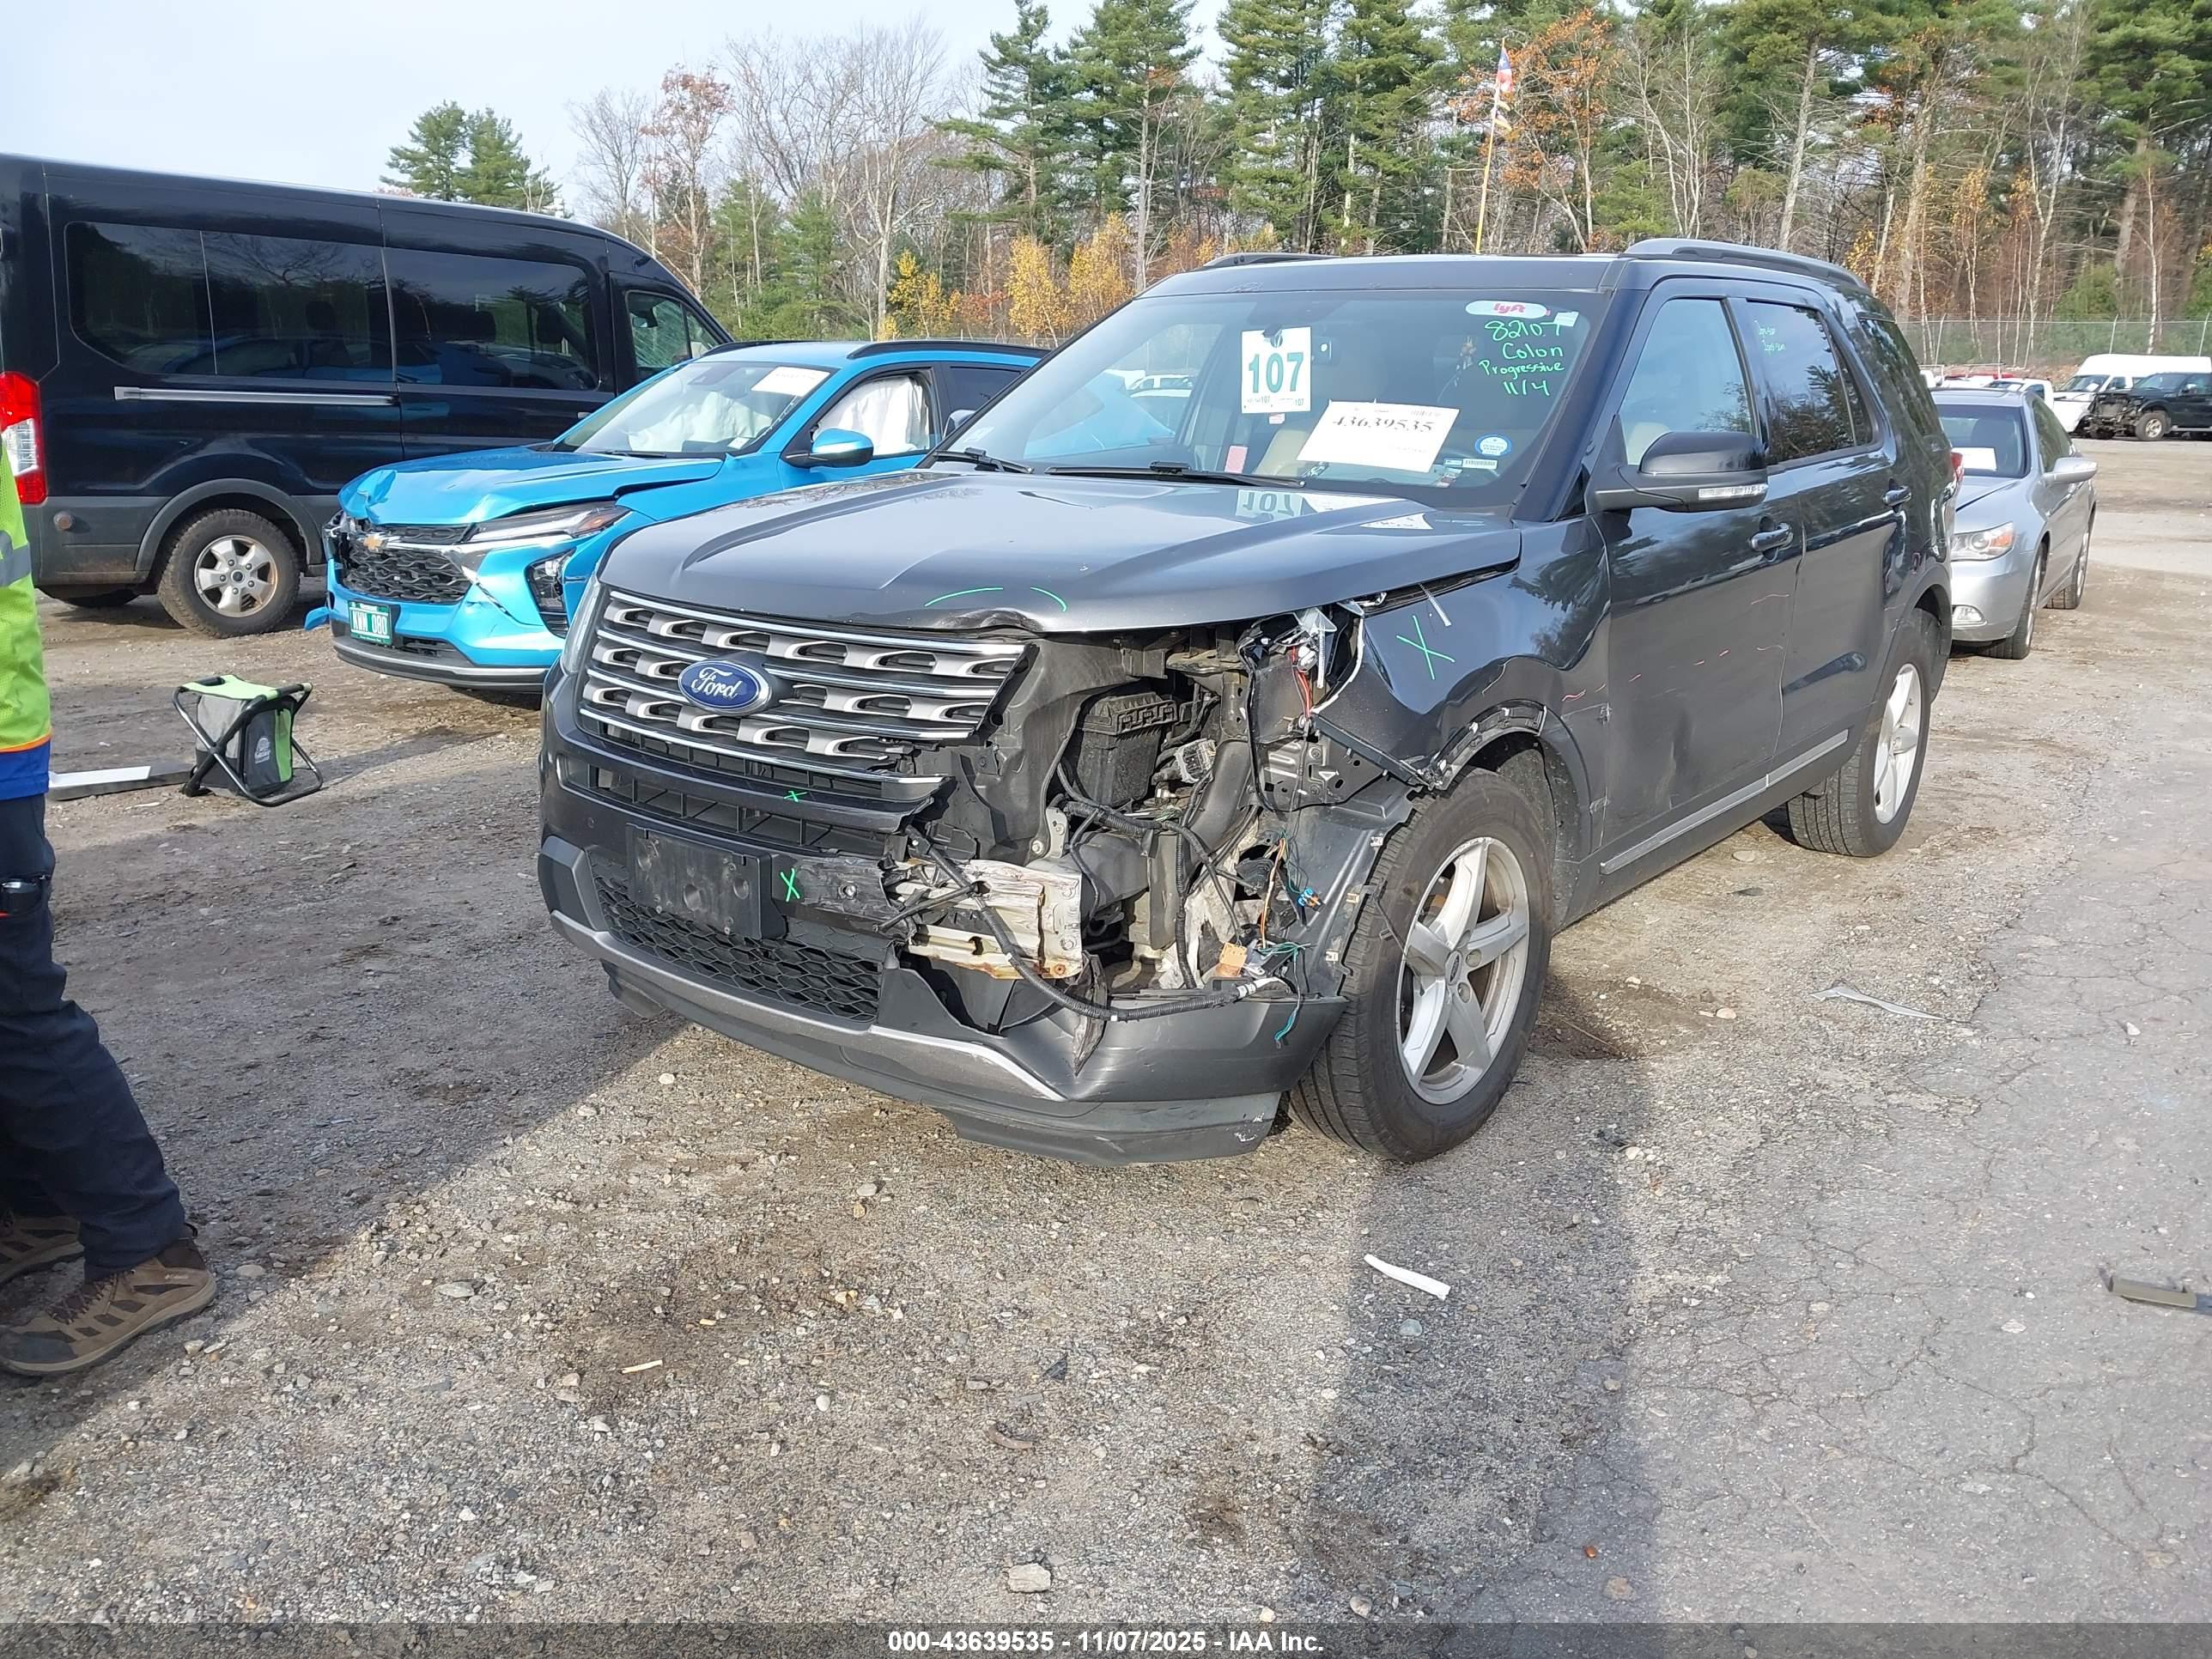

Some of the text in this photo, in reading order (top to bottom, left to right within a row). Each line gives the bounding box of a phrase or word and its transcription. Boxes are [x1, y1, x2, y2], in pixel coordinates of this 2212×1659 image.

[1493, 302, 1526, 314] lyft
[1502, 342, 1564, 360] Colon
[1249, 351, 1304, 394] 107
[1478, 359, 1565, 380] Progressive
[1332, 416, 1436, 433] 43639535
[690, 666, 744, 700] Ford
